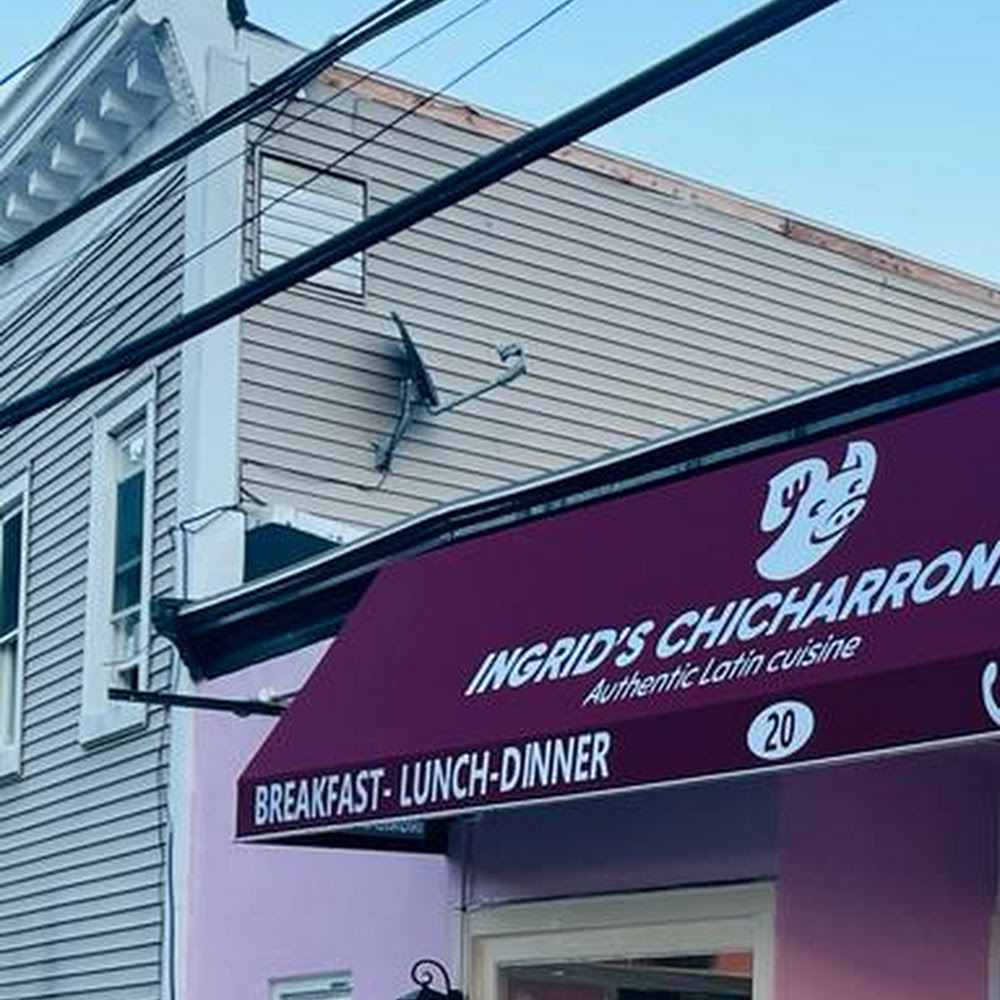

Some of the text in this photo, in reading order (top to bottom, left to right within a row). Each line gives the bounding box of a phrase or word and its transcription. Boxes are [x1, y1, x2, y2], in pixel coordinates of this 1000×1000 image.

[466, 620, 654, 697] INGRID'S
[583, 634, 863, 706] Authentic Latin cuisine
[763, 709, 798, 752] 20
